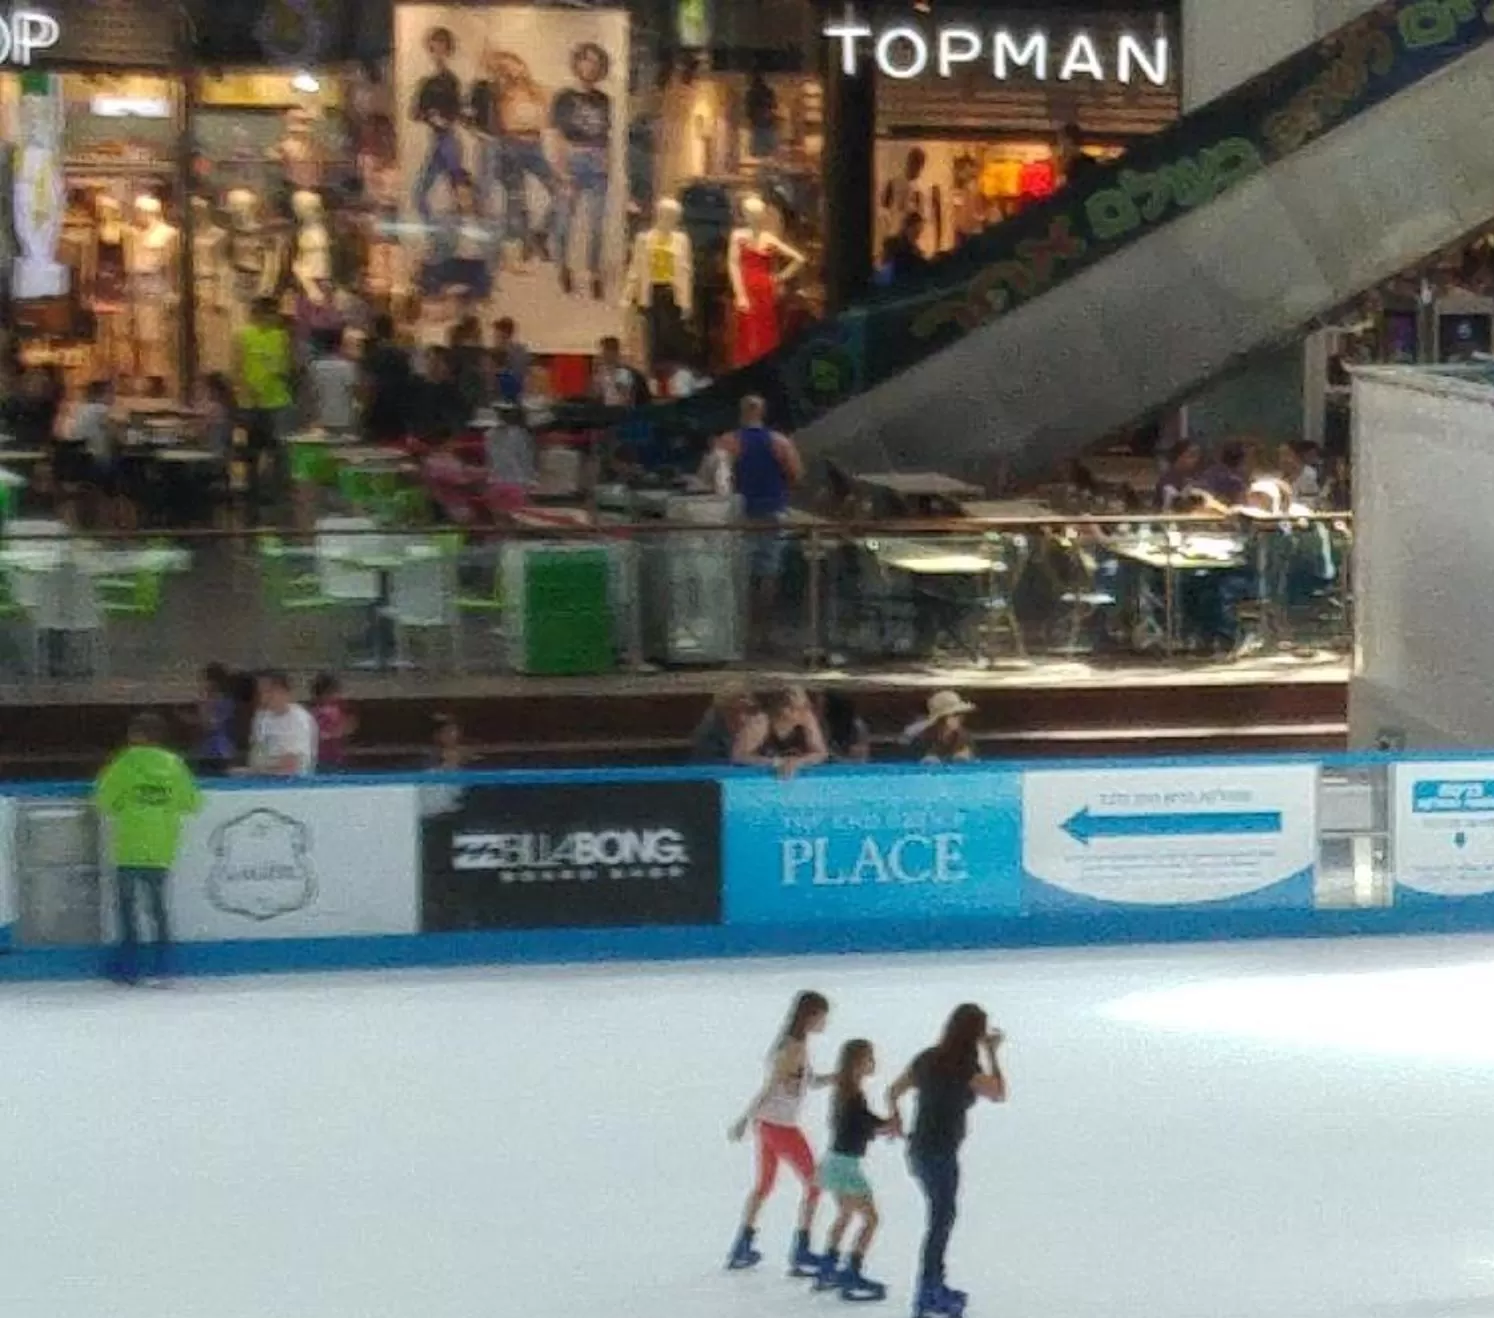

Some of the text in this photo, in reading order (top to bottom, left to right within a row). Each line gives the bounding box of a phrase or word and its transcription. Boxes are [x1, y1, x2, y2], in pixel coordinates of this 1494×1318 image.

[823, 26, 1170, 87] TOPMAN
[499, 829, 690, 869] BILLABONG
[781, 832, 968, 887] PLACE
